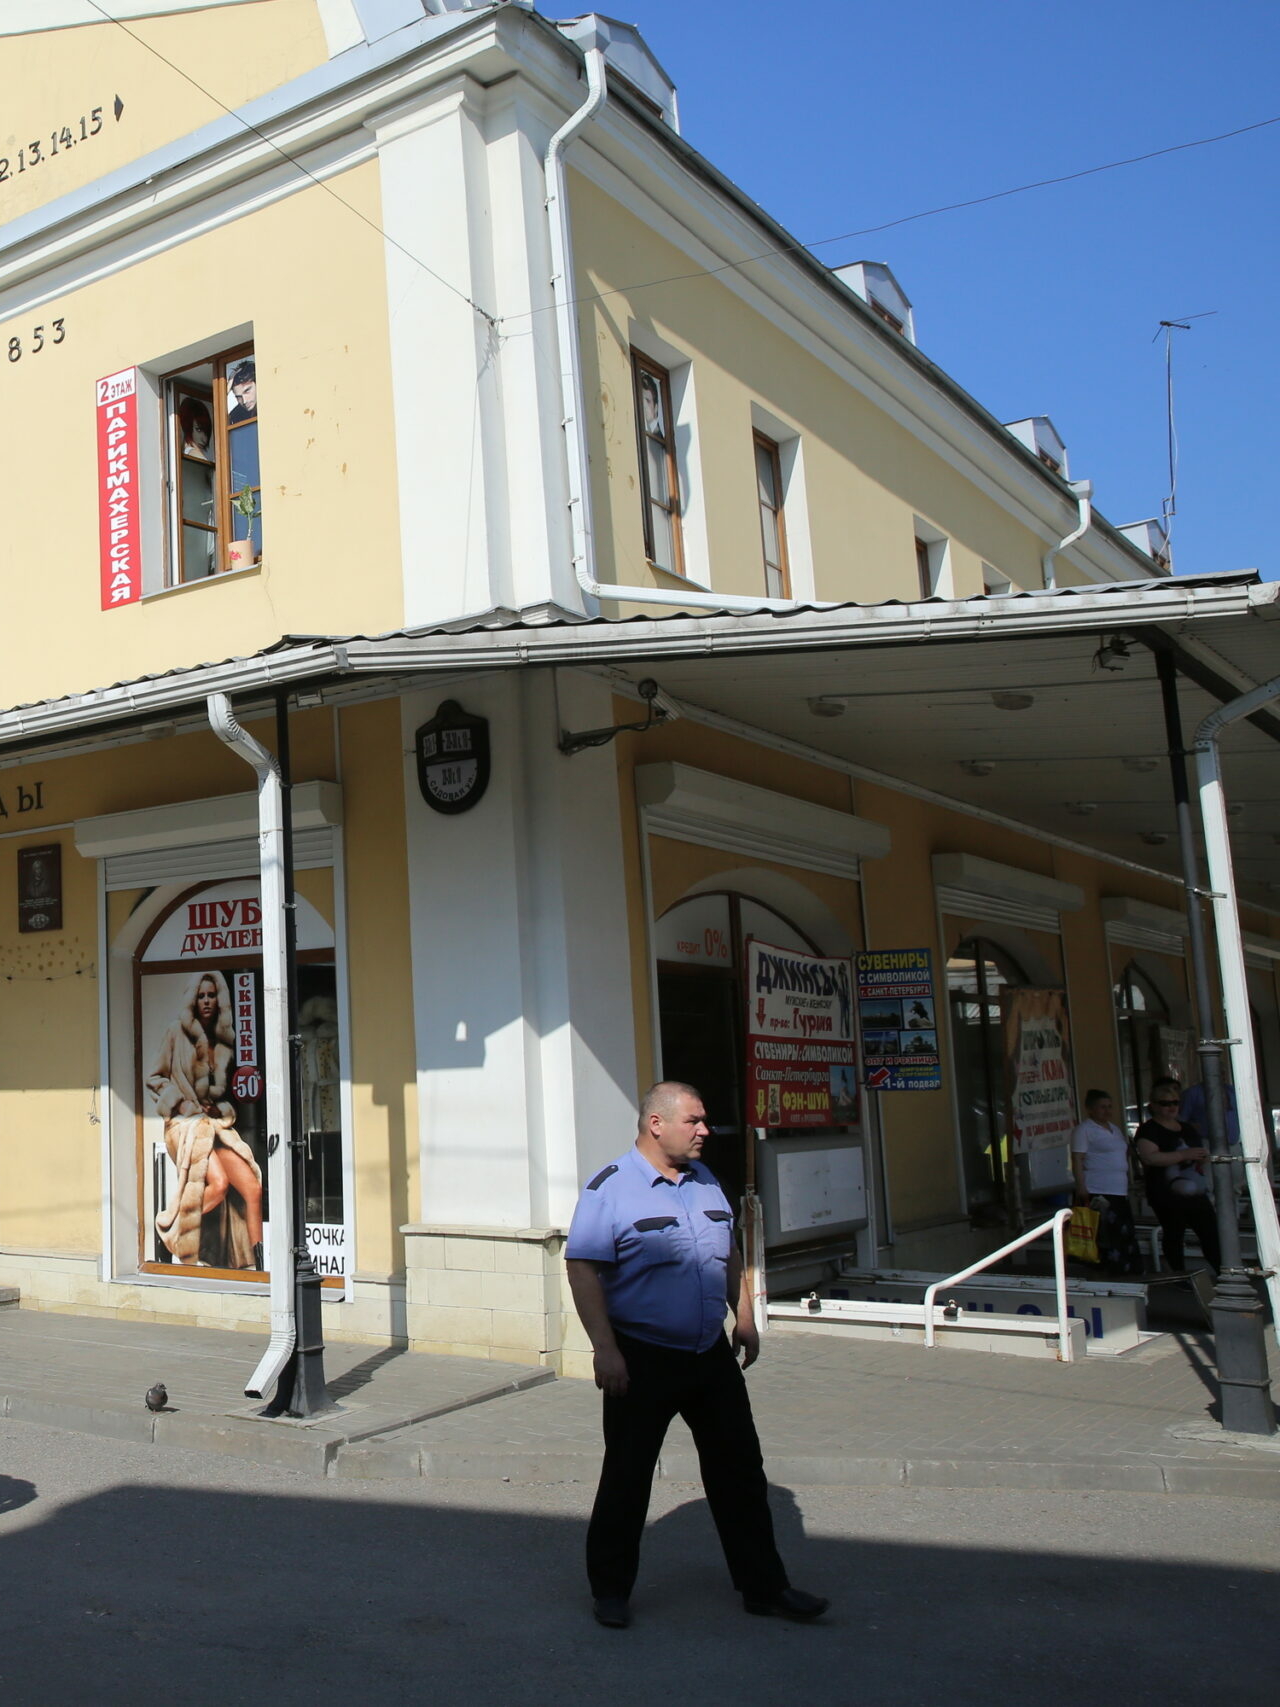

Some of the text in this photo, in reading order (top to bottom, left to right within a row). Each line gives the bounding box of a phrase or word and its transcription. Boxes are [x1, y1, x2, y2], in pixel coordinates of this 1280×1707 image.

[100, 380, 133, 403] 2 ЭТАЖ
[105, 400, 132, 604] ПАРИКМАХЕРСКАЯ
[187, 897, 262, 931] ШУБ
[180, 927, 263, 957] ДУБЛЕН
[858, 952, 928, 971] СУВЕНИРЫ
[756, 951, 840, 998] ДЖИНСЫ
[867, 968, 931, 983] СИМВОЛИКОЙ
[867, 984, 930, 996] САНКТ-ПЕТЕРБУРГА
[238, 974, 254, 1063] СКИДКИ
[792, 1007, 833, 1037] Турция
[754, 1040, 799, 1062] СУВЕНИРЫ
[801, 1043, 853, 1063] СИМВОЛИКОЙ
[865, 1057, 884, 1066] ОПТ
[894, 1055, 939, 1065] РОЗНИЦА
[755, 1065, 830, 1087] Санкт-Петербурга
[908, 1079, 941, 1090] подвал
[782, 1087, 830, 1111] ФЭН-ШУЙ
